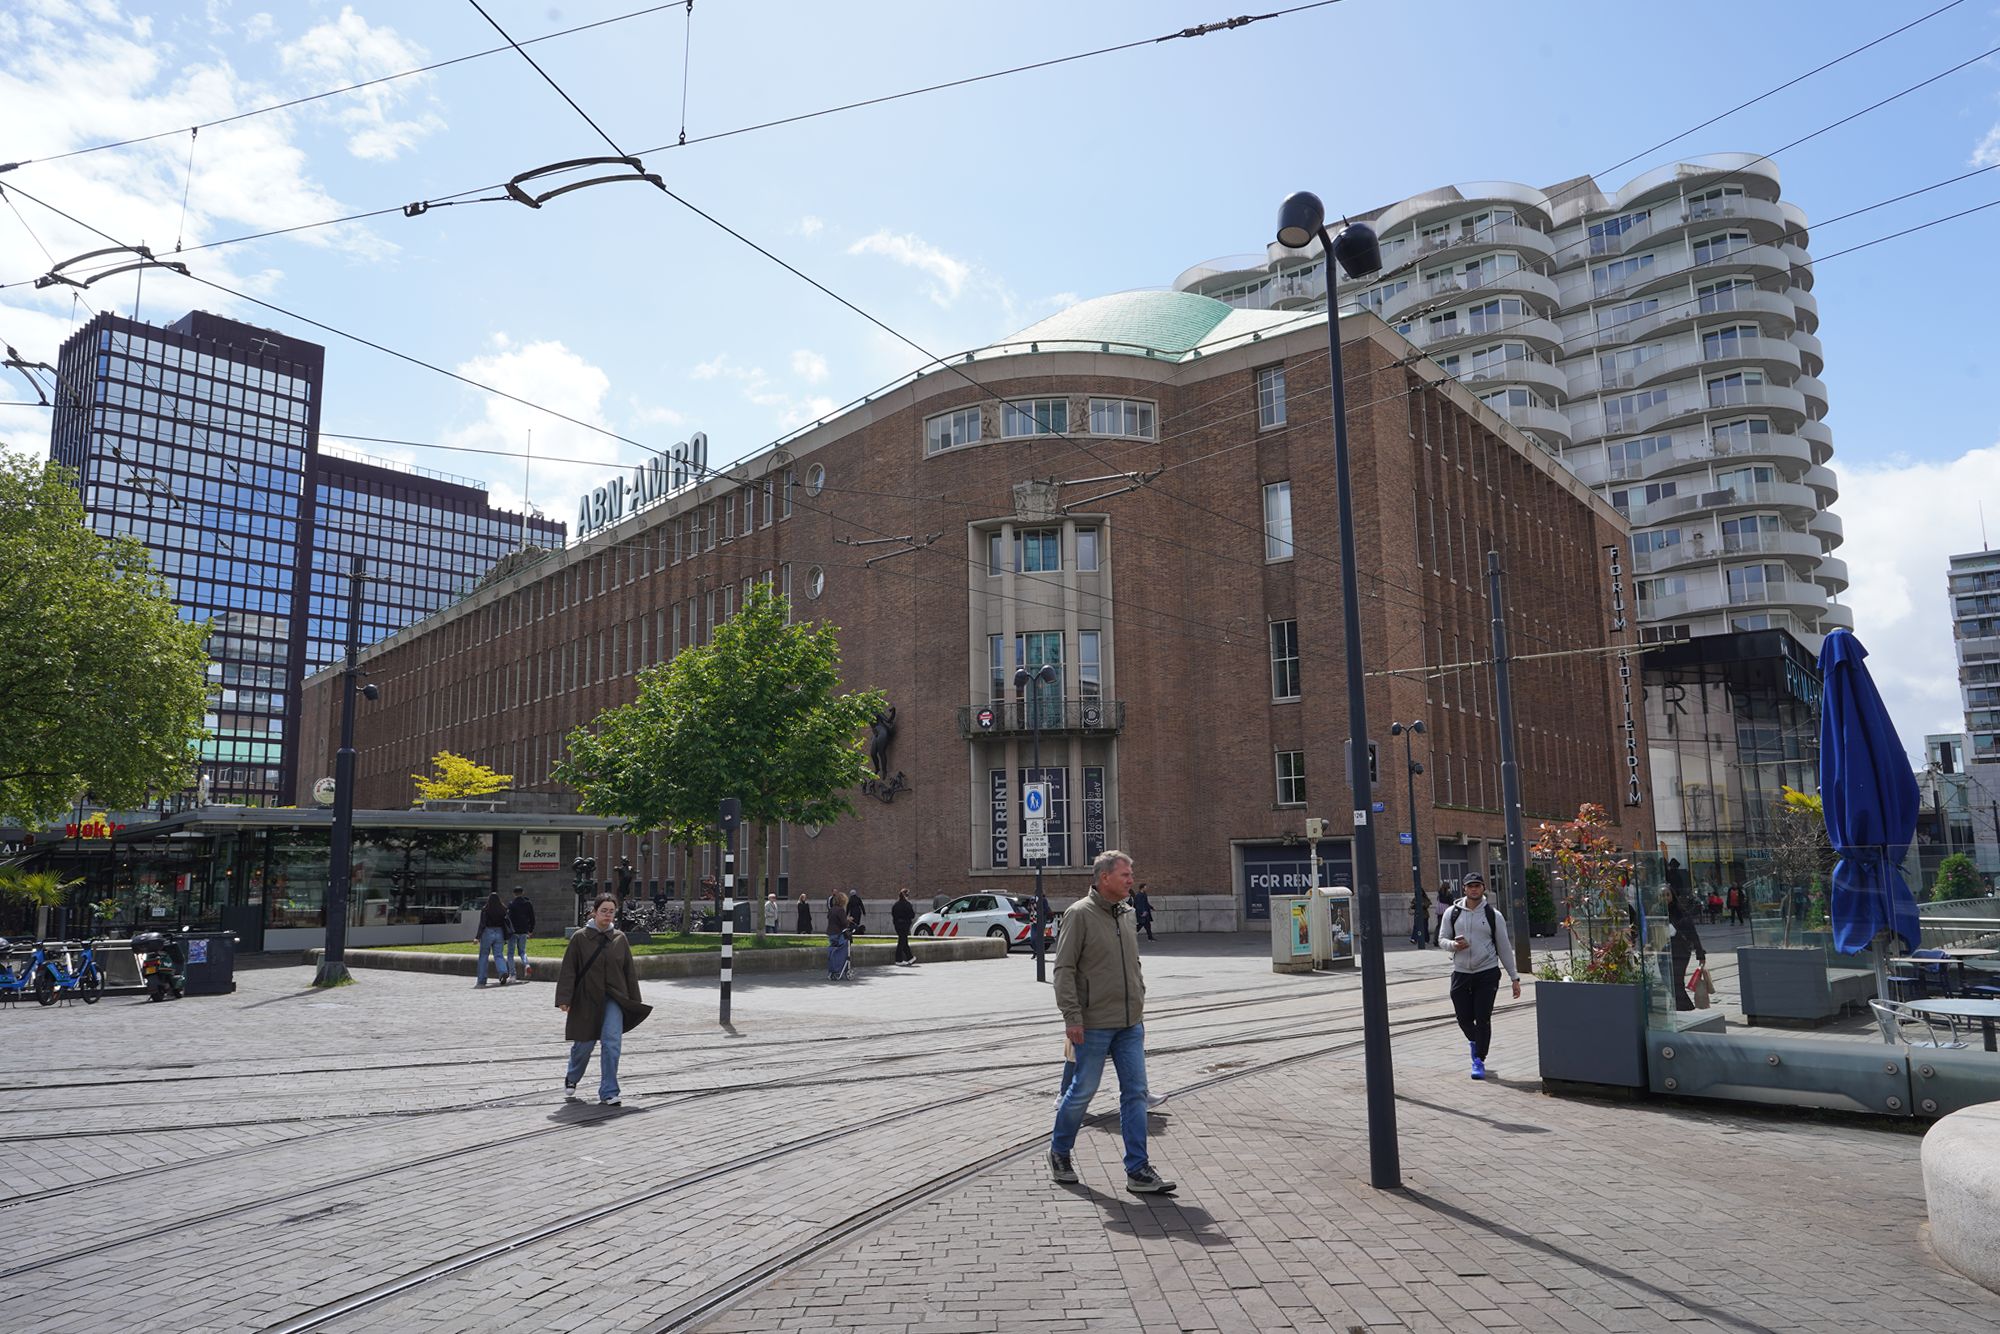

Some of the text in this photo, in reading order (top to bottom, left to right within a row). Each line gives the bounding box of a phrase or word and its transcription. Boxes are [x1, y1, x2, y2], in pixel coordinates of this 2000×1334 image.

[1610, 547, 1626, 629] FORUM
[1618, 650, 1641, 803] ROTTERDAM
[66, 822, 104, 838] wok
[995, 776, 1008, 862] FOR RENT
[523, 850, 556, 858] la Borsa
[1250, 874, 1280, 888] FOR
